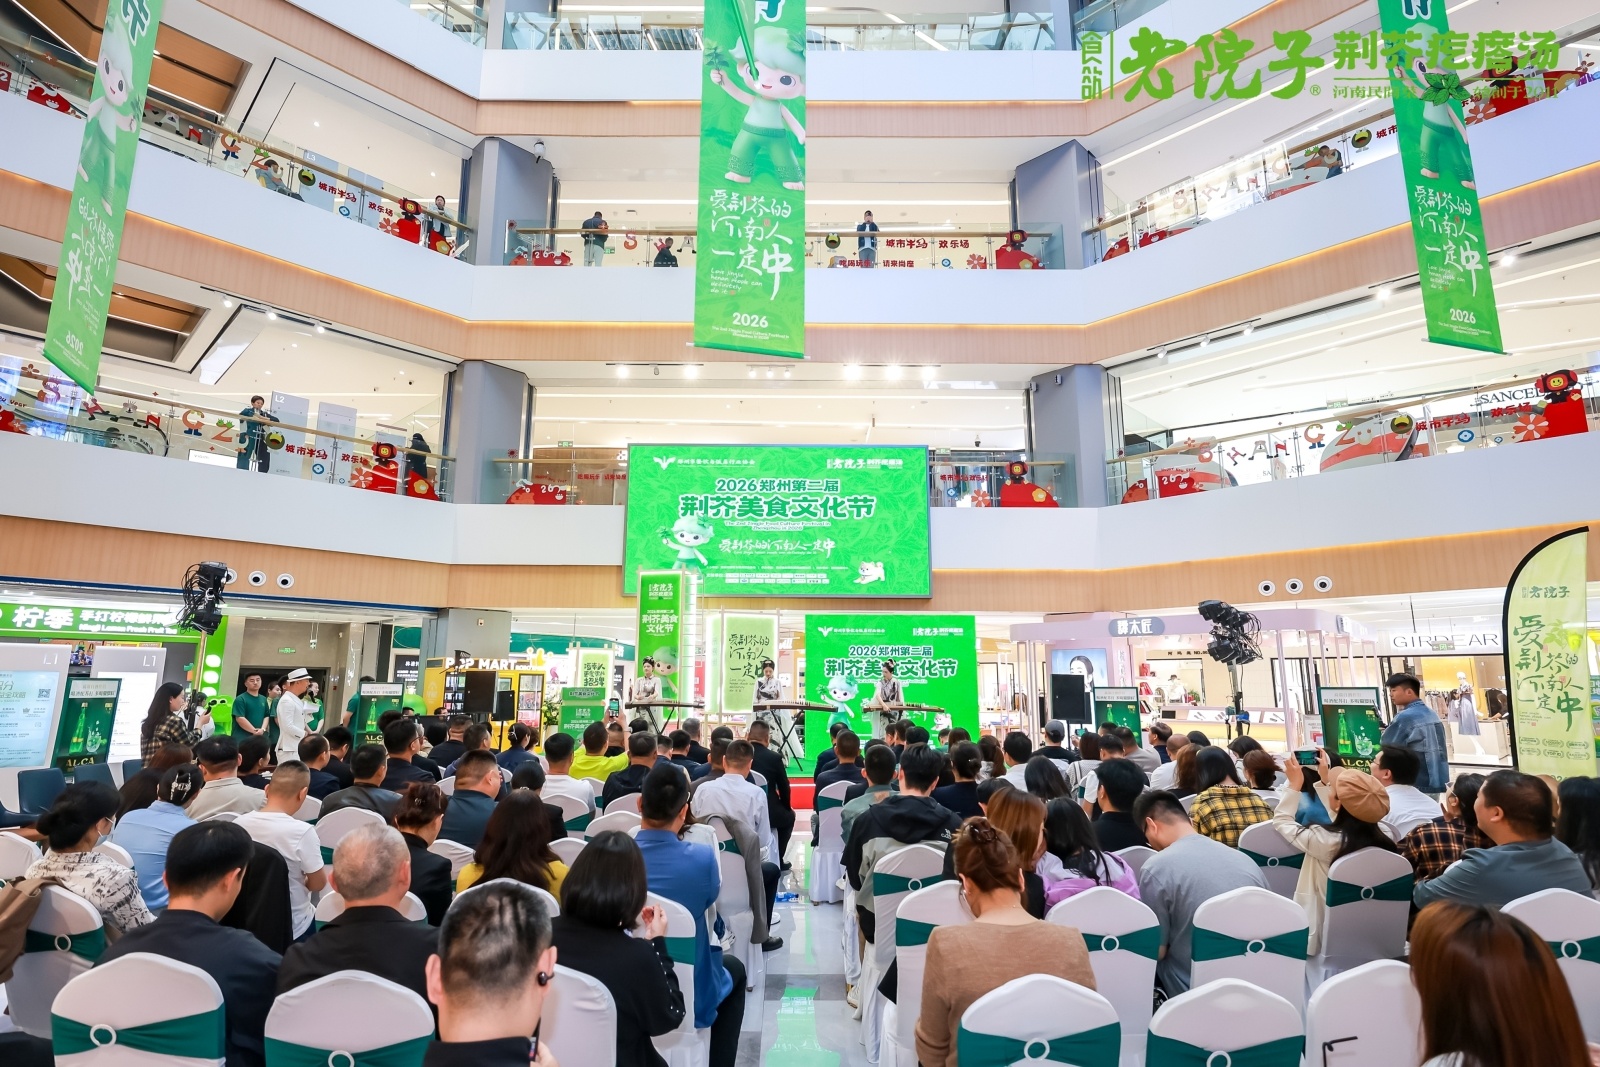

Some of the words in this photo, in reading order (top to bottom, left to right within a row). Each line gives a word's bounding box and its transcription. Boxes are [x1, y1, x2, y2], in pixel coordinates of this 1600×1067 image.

[306, 153, 316, 162] L3
[368, 201, 394, 218] 欢乐场
[938, 239, 970, 249] 欢乐场
[712, 244, 794, 300] 一定中
[1424, 240, 1484, 297] 一定中
[732, 312, 768, 328] 2026
[1450, 308, 1476, 324] 2026
[275, 394, 286, 404] L2
[1491, 402, 1532, 418] 欢乐场
[716, 478, 840, 492] 2026郑州第二届
[680, 495, 876, 518] 荆芥美食文化节
[12, 606, 74, 630] 柠季
[646, 624, 674, 633] 文化节
[1513, 615, 1546, 650] 爱
[849, 646, 932, 656] 2026郑州第二届
[478, 658, 516, 670] MART
[1518, 691, 1584, 732] 一定中
[66, 757, 95, 767] ALCA
